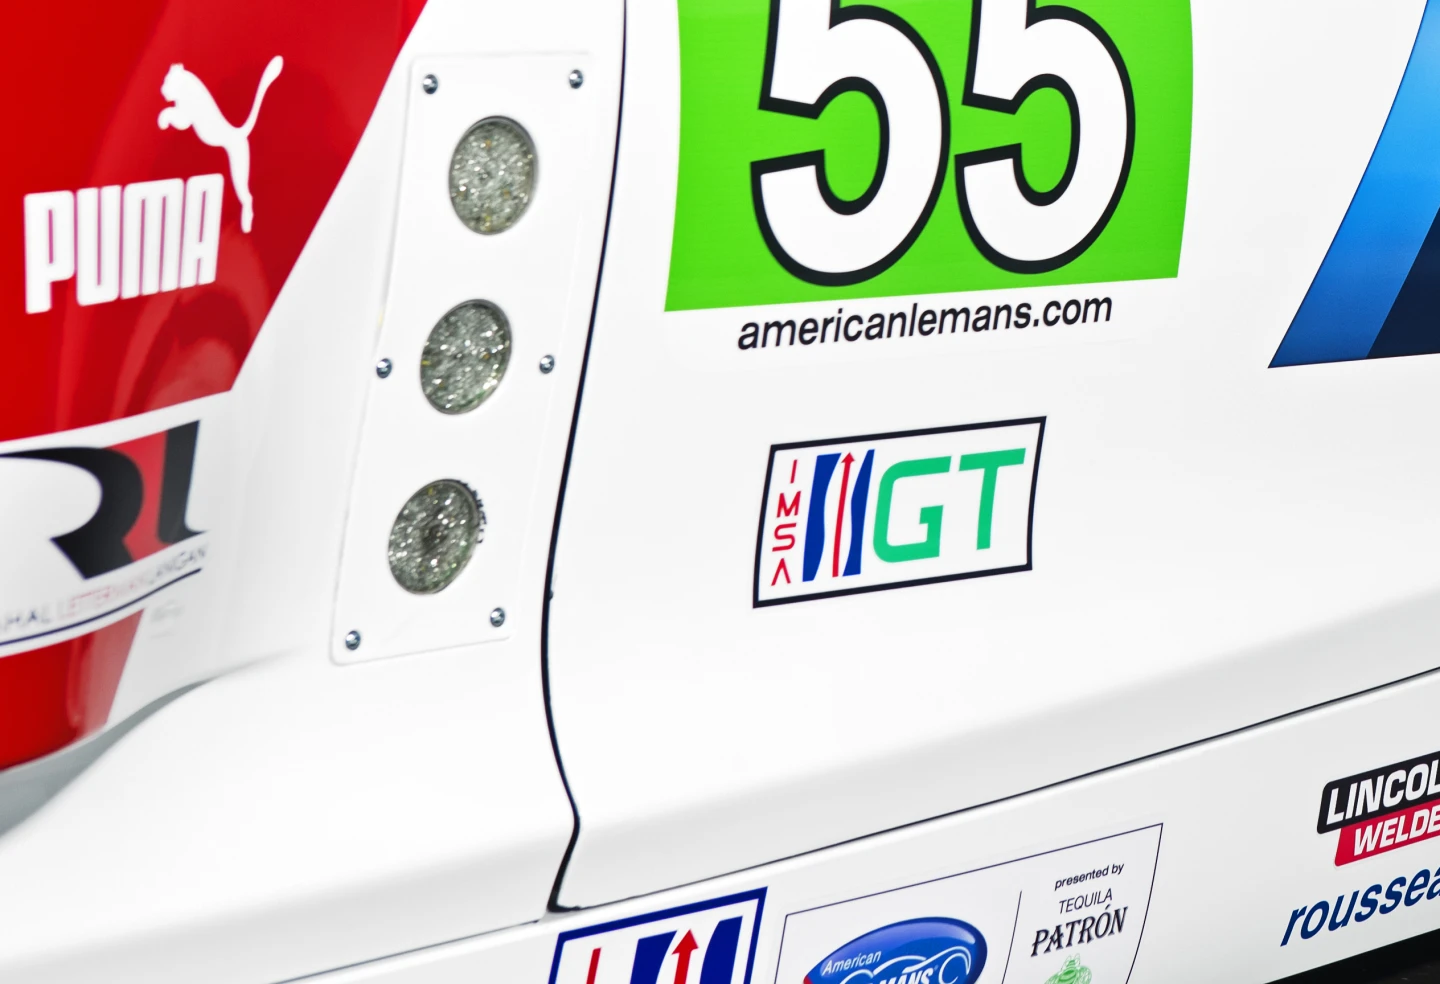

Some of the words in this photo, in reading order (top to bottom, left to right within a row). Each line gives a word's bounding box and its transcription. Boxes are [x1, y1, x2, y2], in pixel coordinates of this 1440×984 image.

[23, 173, 224, 315] PUMA
[737, 296, 1113, 351] americanlemans.com
[872, 447, 1027, 564] GT
[1053, 864, 1110, 892] presented
[1110, 863, 1125, 876] by
[1058, 887, 1113, 915] TEQUILA
[1030, 903, 1129, 958] PATRÓN
[821, 950, 882, 977] American
